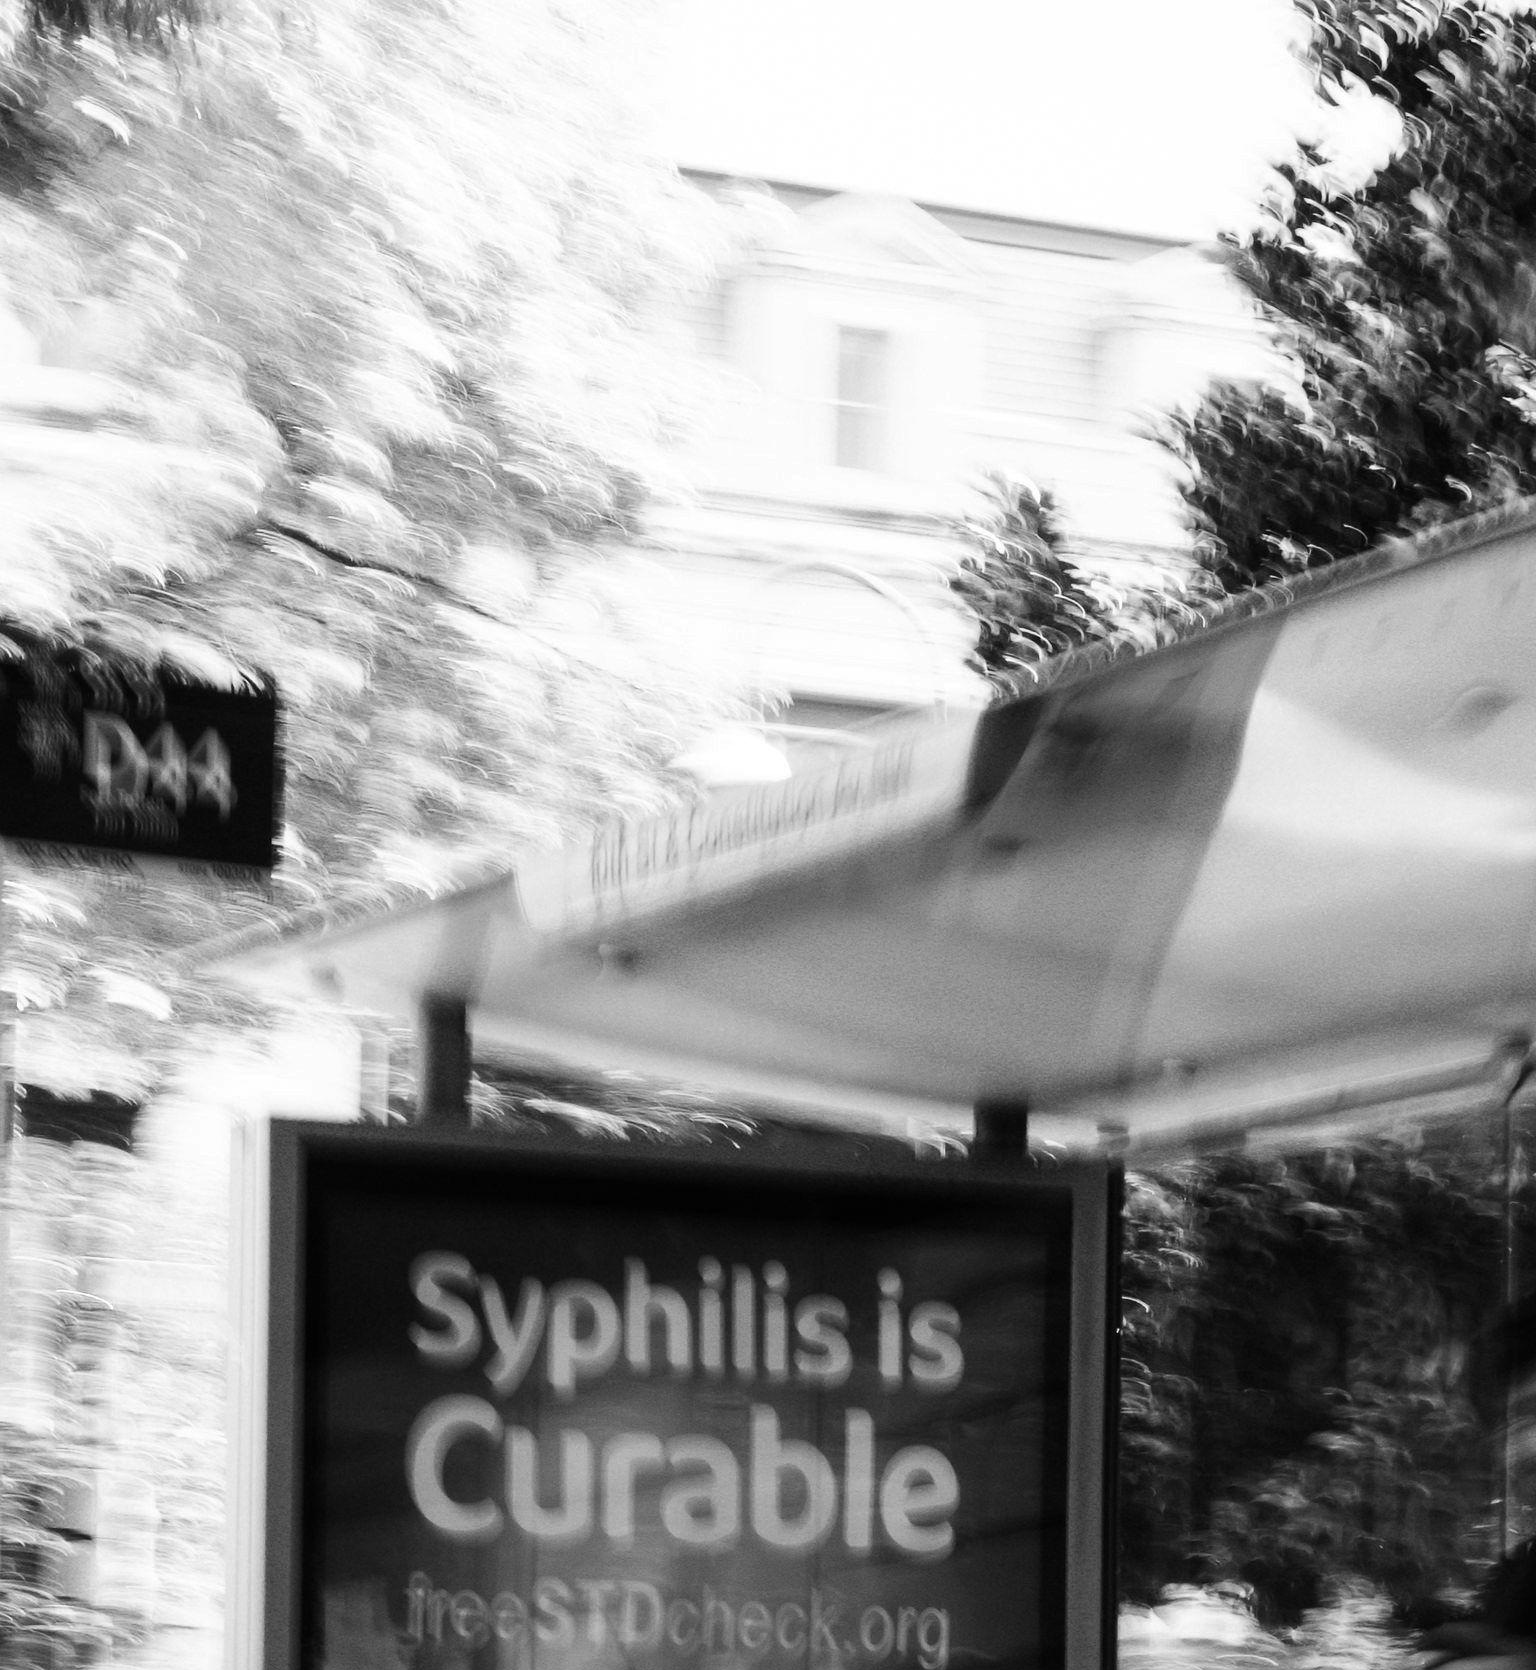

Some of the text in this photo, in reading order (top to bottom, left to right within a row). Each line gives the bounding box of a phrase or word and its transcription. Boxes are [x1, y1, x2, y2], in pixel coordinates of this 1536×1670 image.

[408, 1249, 965, 1394] Syphilis is
[405, 1393, 960, 1561] Curable
